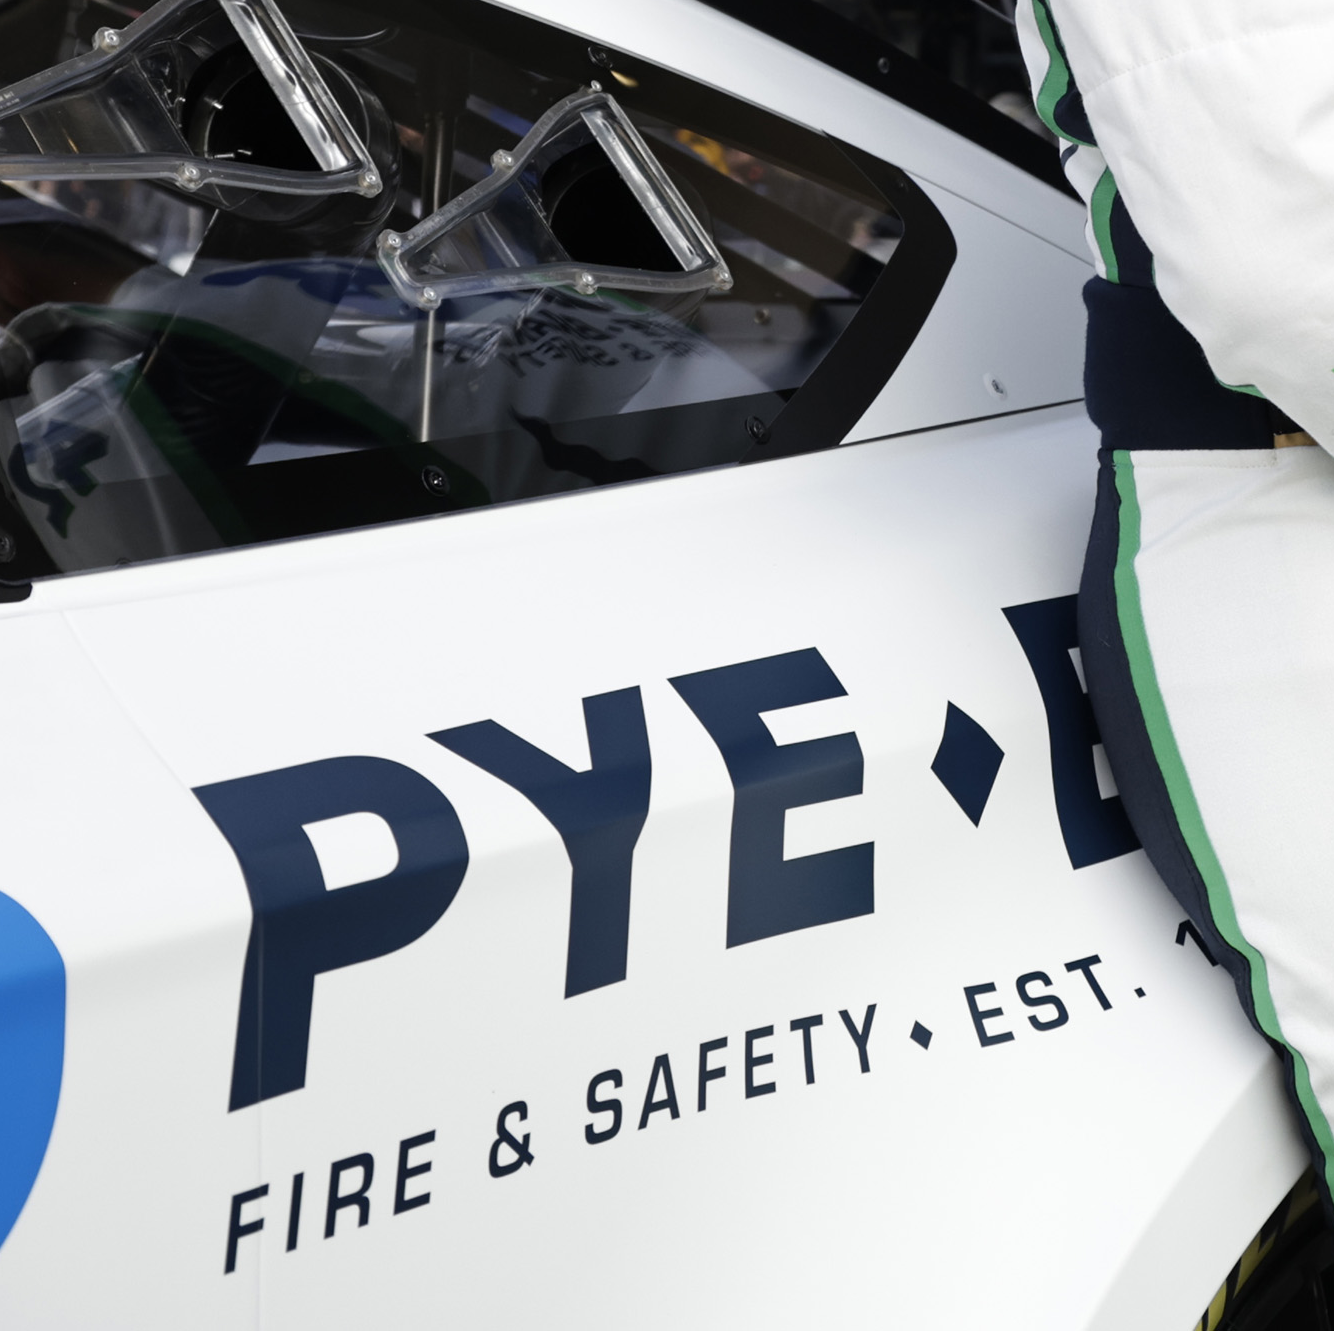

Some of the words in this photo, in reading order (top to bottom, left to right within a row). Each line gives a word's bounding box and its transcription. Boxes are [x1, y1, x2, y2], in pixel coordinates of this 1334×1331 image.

[190, 645, 876, 1115] PYE
[222, 1127, 438, 1276] FIRE
[487, 1099, 535, 1180] &
[582, 1002, 879, 1146] SAFETY
[963, 953, 1148, 1049] EST.
